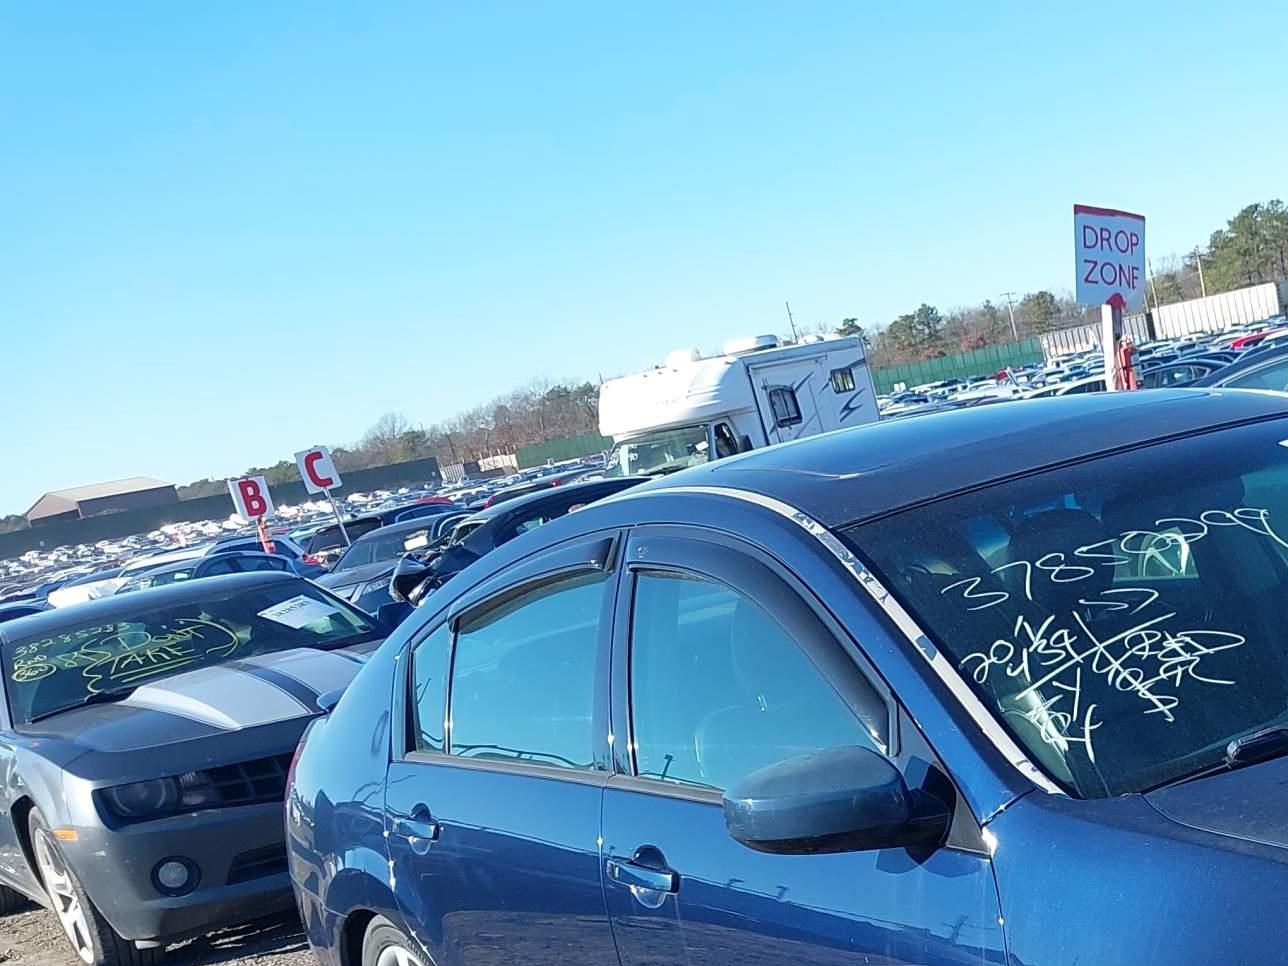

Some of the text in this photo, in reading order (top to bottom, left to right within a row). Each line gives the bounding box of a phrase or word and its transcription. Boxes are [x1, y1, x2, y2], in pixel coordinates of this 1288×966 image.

[1083, 225, 1140, 256] DROP
[1083, 259, 1140, 290] ZONE
[304, 451, 334, 487] C
[238, 480, 267, 516] B
